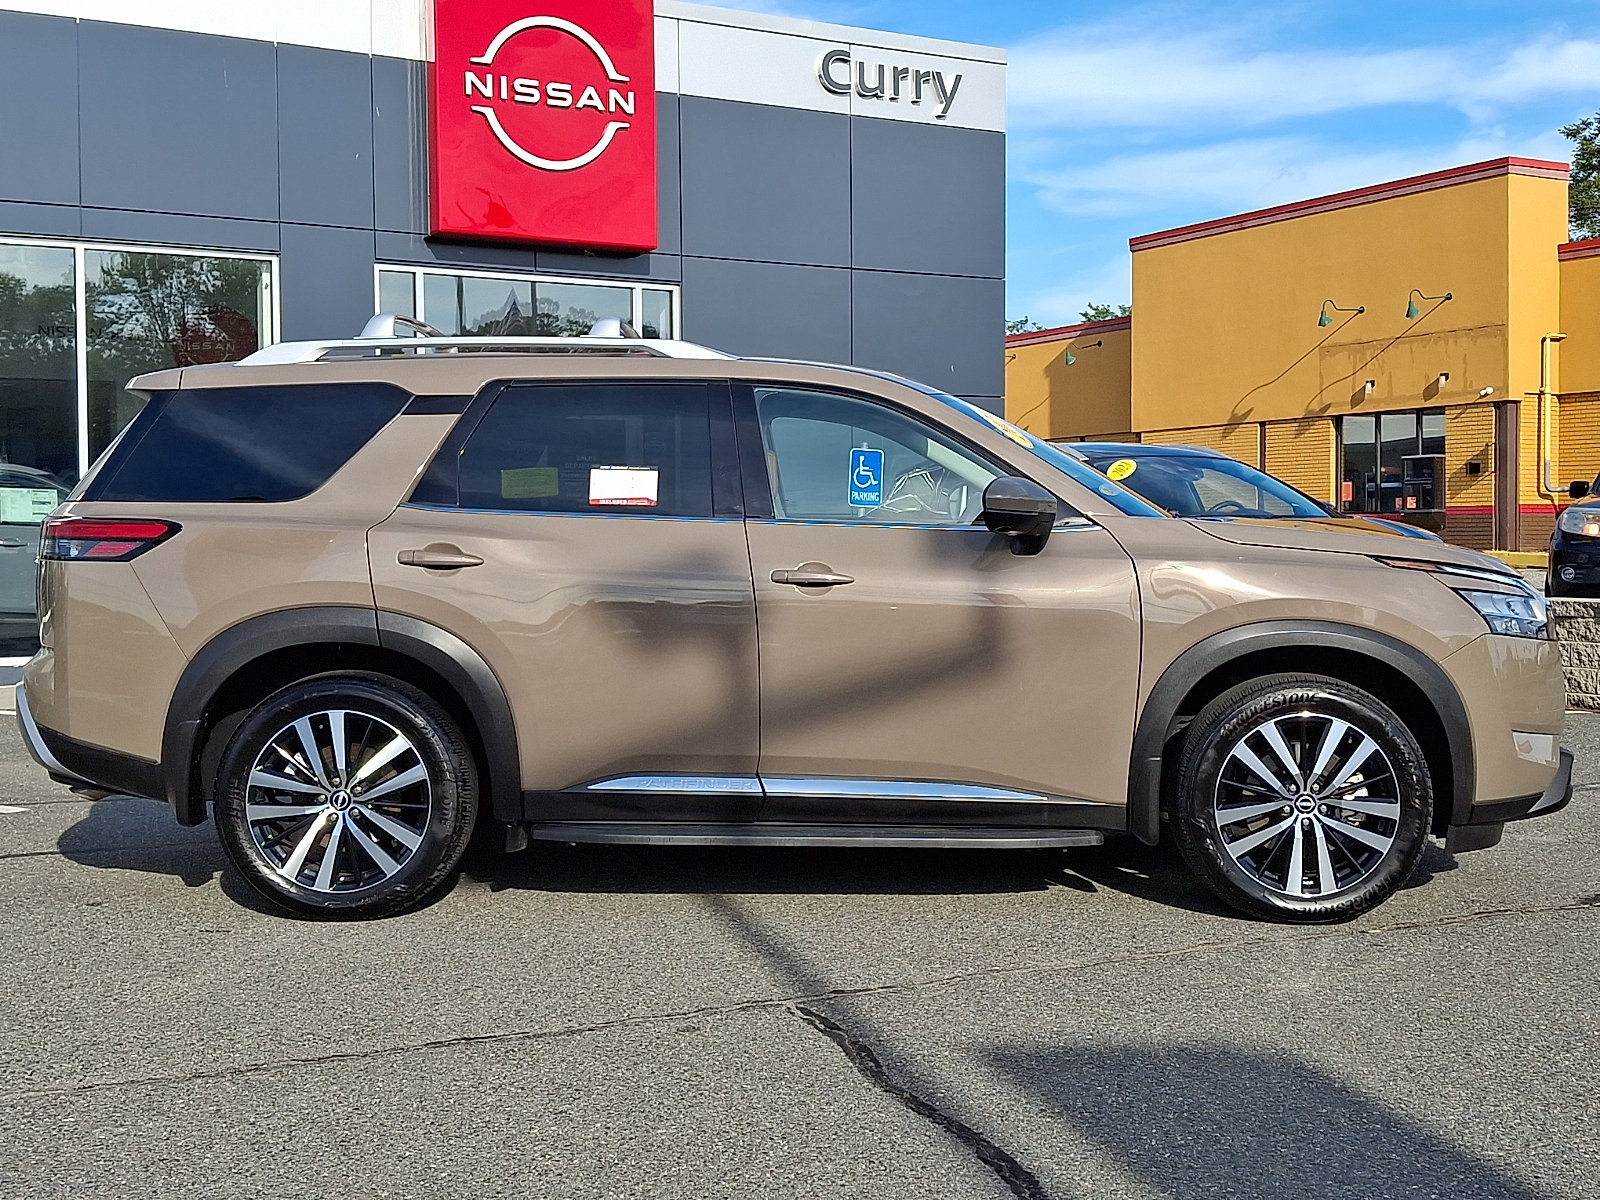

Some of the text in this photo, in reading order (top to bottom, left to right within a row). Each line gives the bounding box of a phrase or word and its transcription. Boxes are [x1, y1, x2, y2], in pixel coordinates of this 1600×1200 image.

[818, 49, 962, 116] Curry
[464, 71, 635, 115] NISSAN
[38, 325, 102, 339] NISSN
[178, 341, 235, 351] NISSAN
[851, 491, 880, 502] PARKING
[636, 779, 754, 790] PATHFINDER
